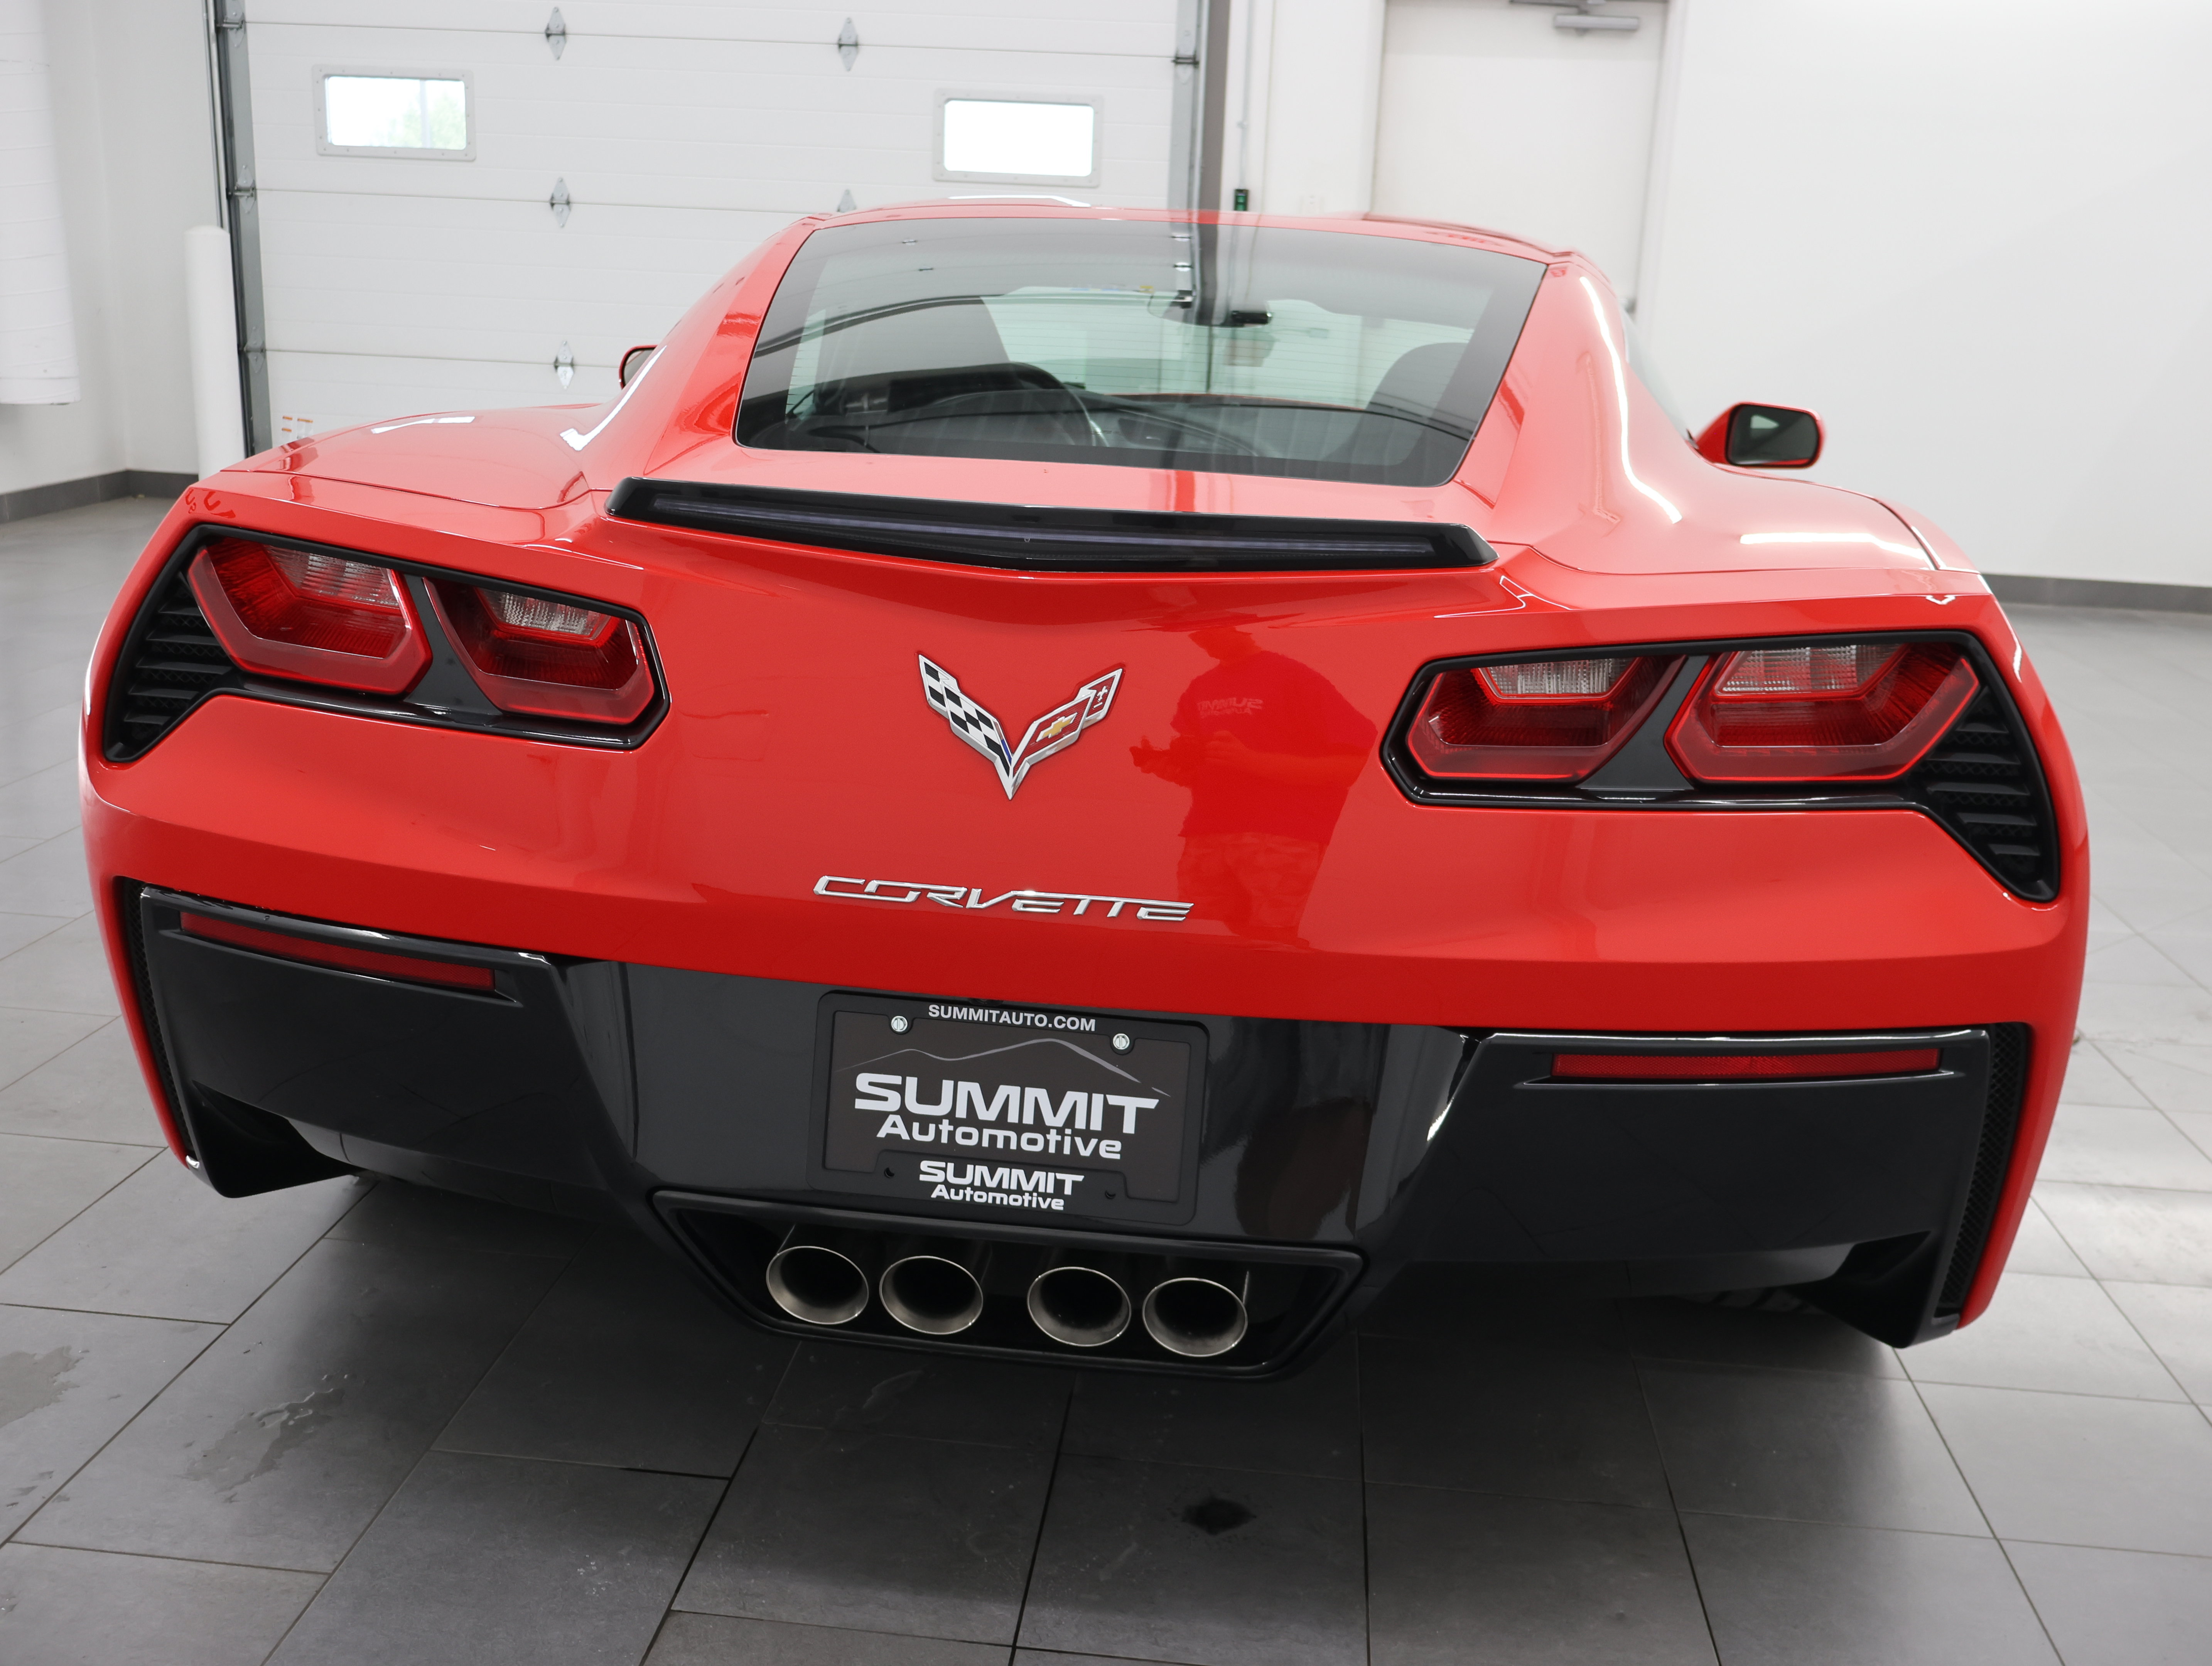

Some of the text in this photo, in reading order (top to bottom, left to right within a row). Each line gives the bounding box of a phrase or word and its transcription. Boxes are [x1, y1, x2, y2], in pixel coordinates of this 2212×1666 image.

[813, 875, 1194, 921] CORVETTE
[928, 1004, 1096, 1032] SUMMITAUTO.COM
[854, 1072, 1159, 1134] SUMMIT
[876, 1114, 1122, 1160] Automotive
[919, 1160, 1085, 1196] SUMMIT
[930, 1184, 1065, 1211] Automotive
